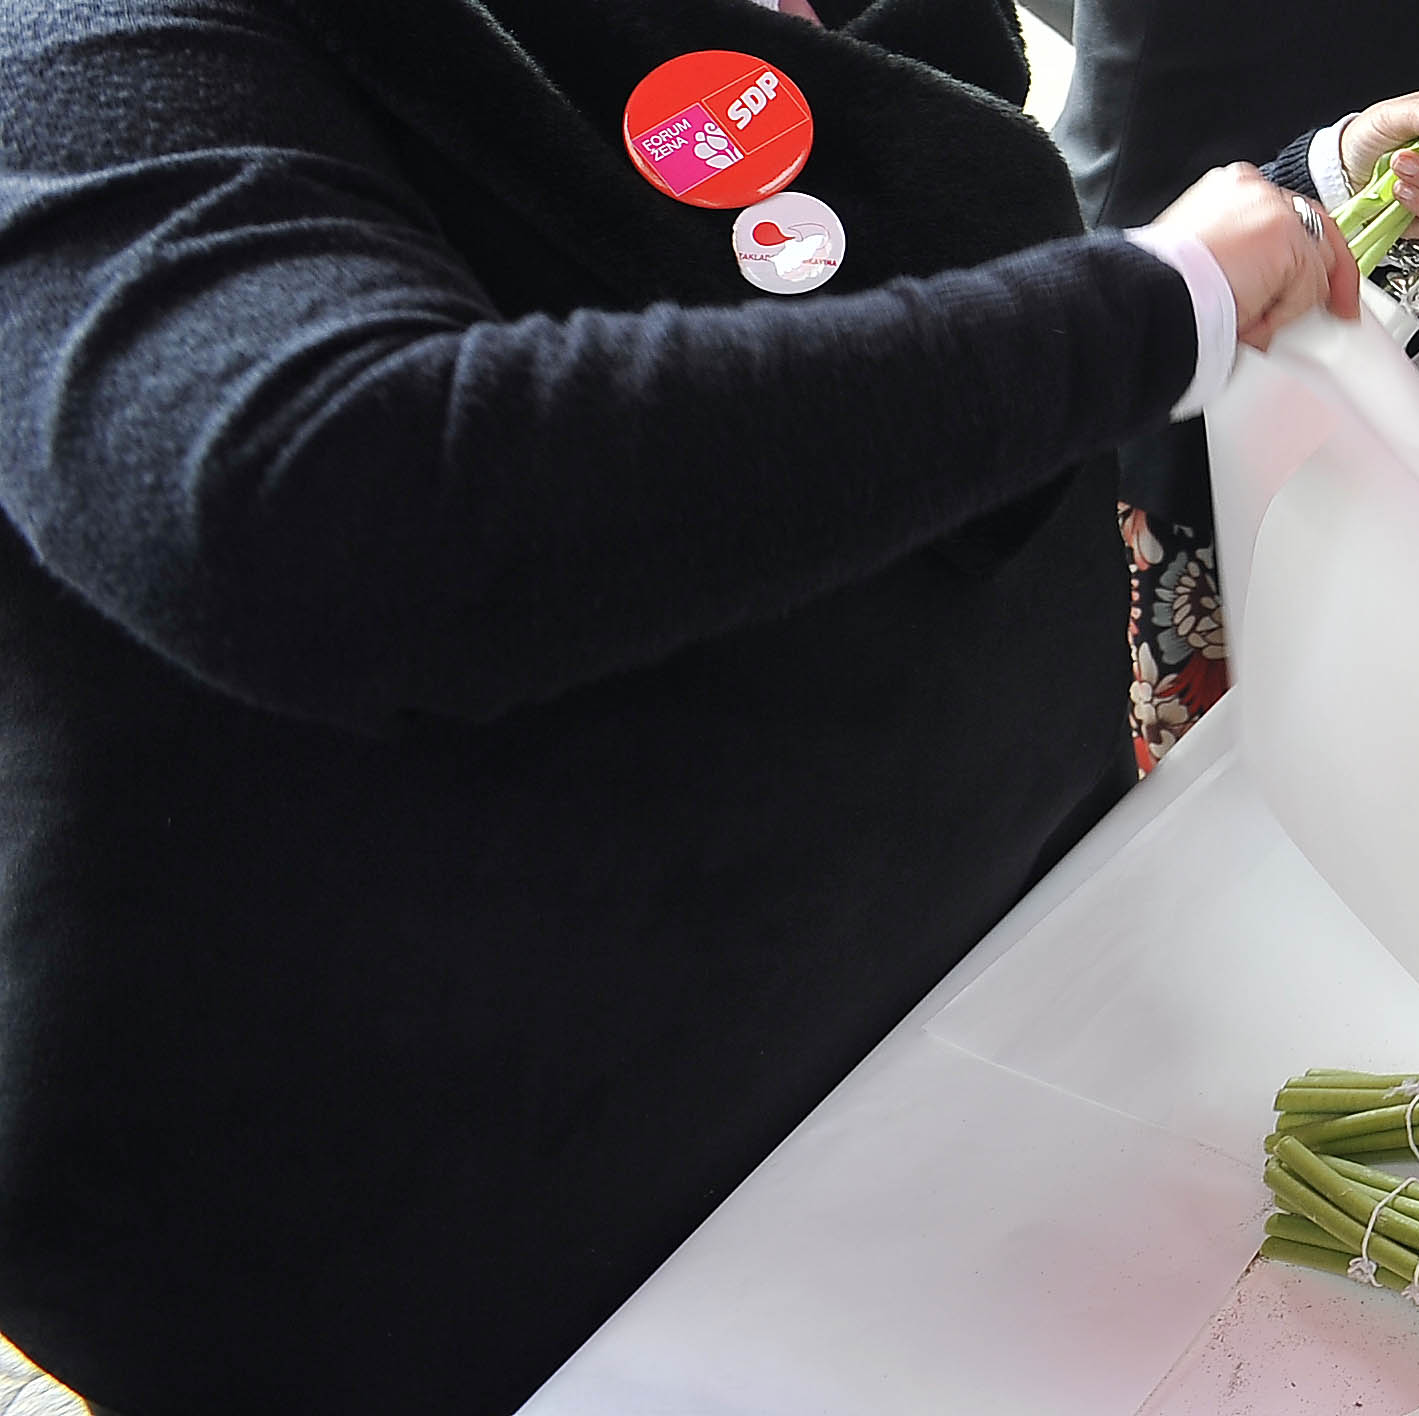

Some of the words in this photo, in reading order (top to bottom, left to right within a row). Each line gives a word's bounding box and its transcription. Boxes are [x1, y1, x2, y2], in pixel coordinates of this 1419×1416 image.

[726, 70, 780, 131] SDP
[641, 117, 693, 153] FORUM
[651, 136, 689, 162] ŽENA
